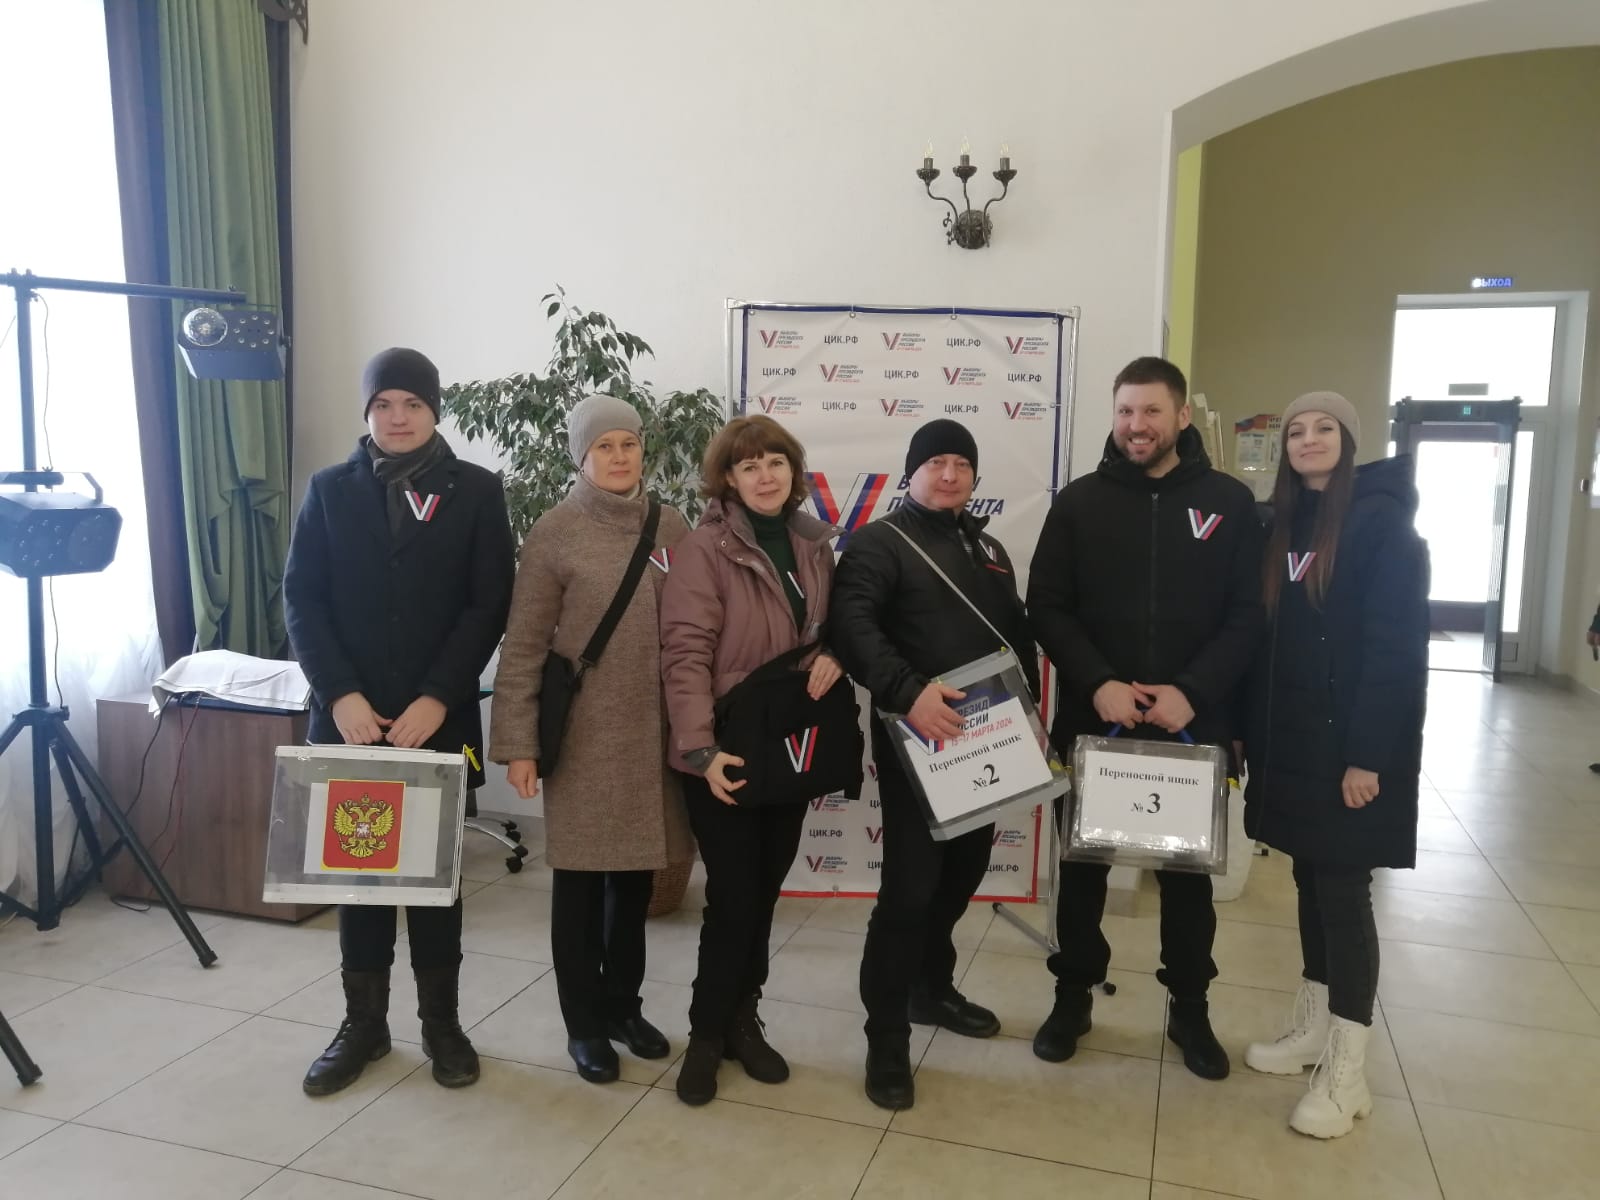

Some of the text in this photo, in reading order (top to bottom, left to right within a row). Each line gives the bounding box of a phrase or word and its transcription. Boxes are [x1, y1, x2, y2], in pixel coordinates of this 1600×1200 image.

[824, 335, 859, 344] ЦИК.РФ
[946, 337, 981, 347] ЦИК.РФ
[762, 367, 797, 376] ЦИК.РФ
[884, 370, 919, 379] ЦИК.РФ
[1007, 373, 1042, 382] ЦИК.РФ
[822, 401, 857, 411] ЦИК.РФ
[944, 404, 979, 414] ЦИК.РФ
[971, 723, 995, 740] МАРТА
[929, 734, 1022, 773] Переносной ящик
[1099, 767, 1199, 786] Переносной ящик
[809, 828, 843, 838] ЦИК.РФ
